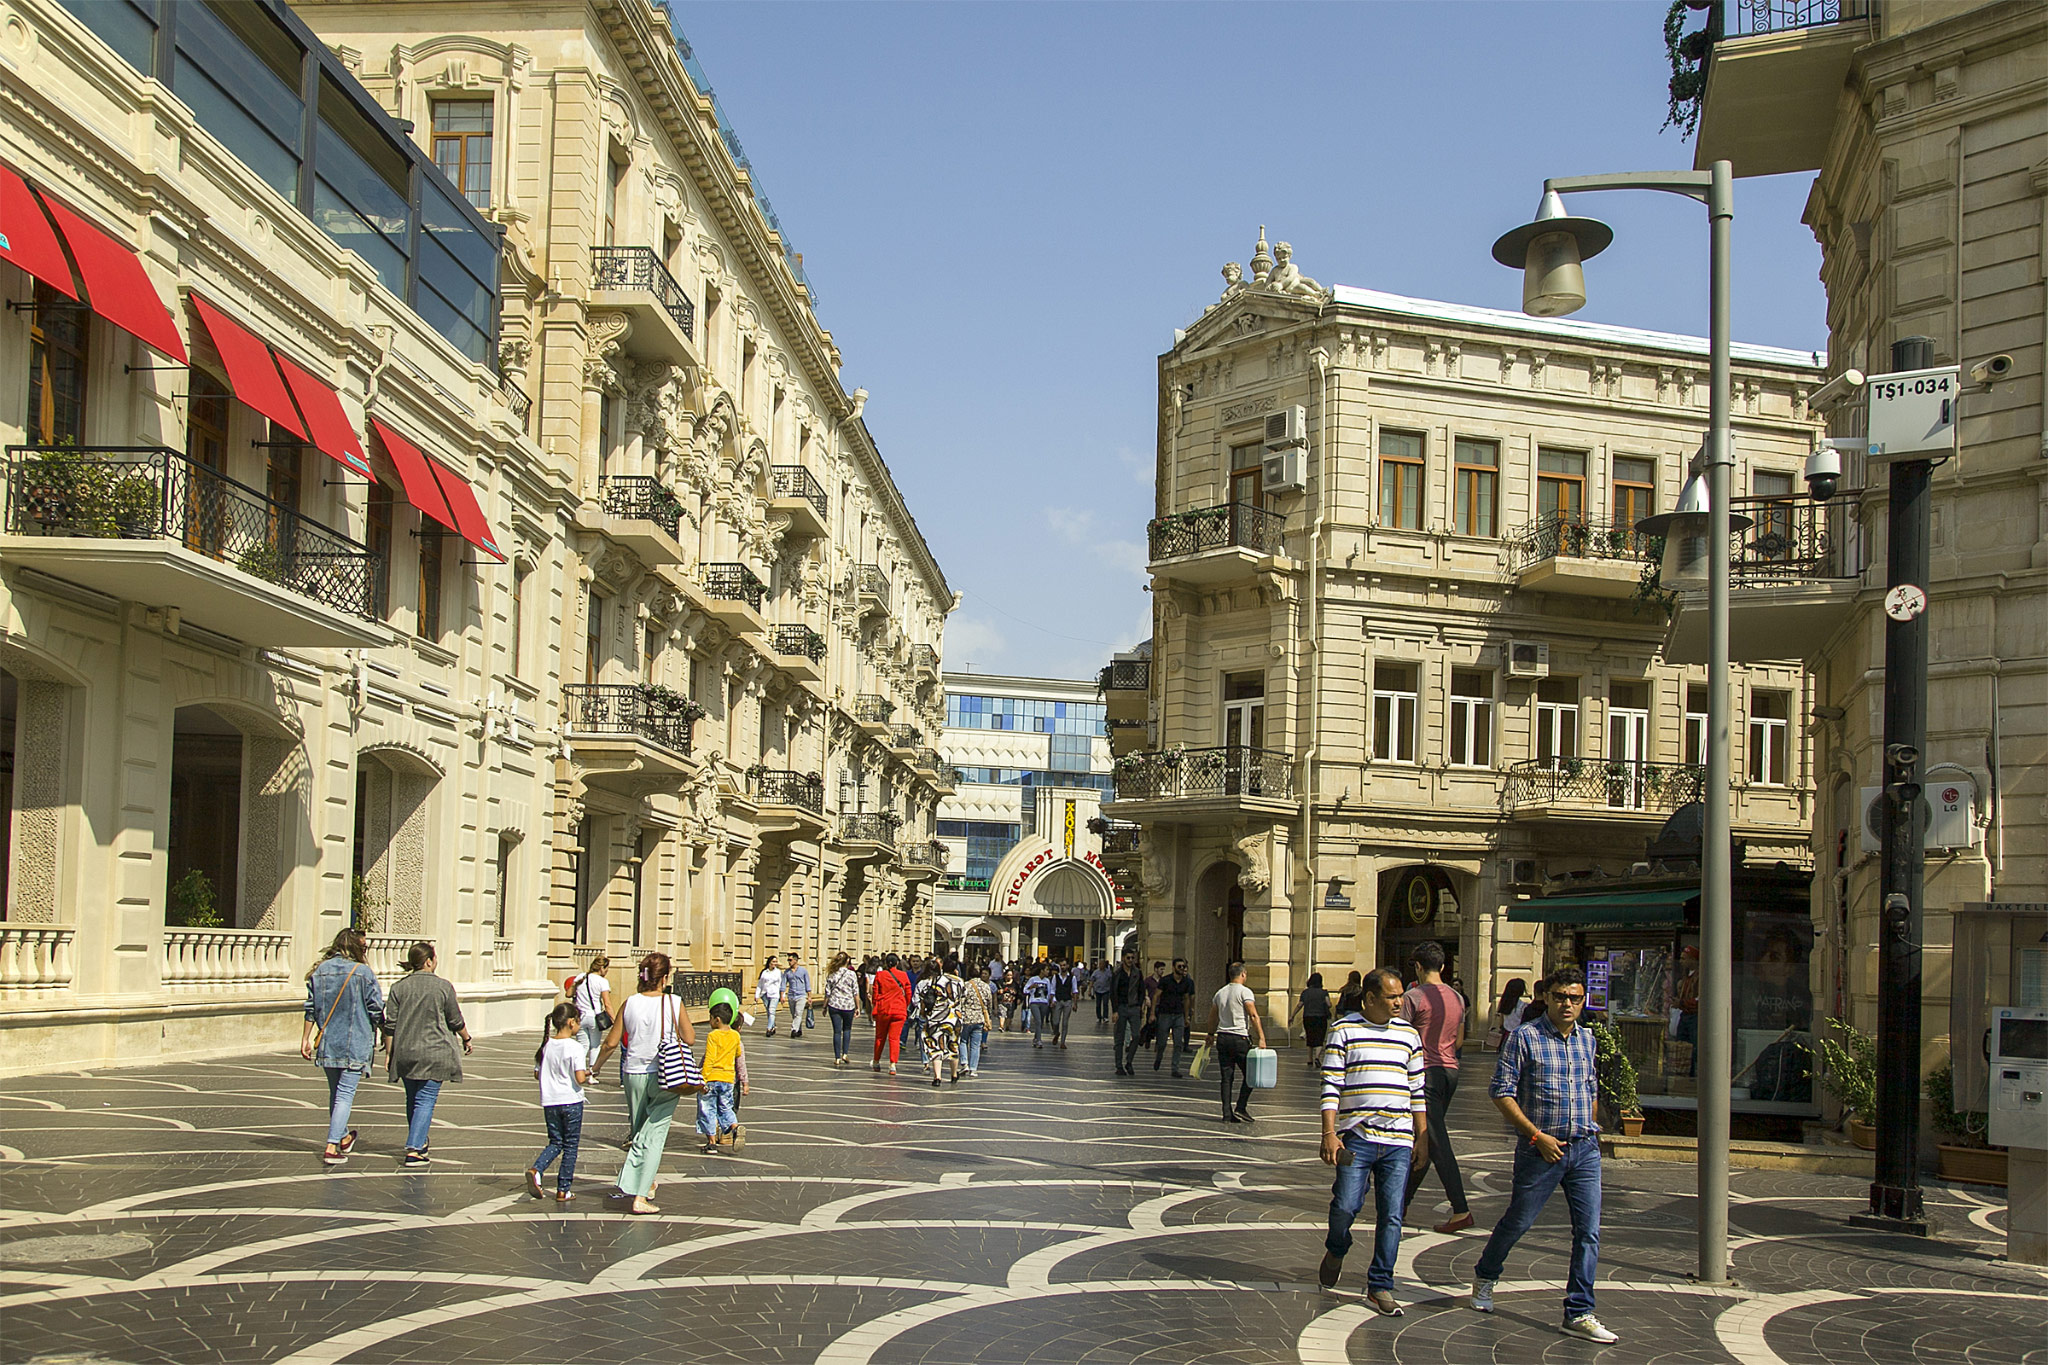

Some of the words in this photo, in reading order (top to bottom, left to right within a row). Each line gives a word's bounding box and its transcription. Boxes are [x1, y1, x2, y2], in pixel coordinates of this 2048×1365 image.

[1875, 378, 1949, 401] TŞ1-034
[1944, 804, 1958, 812] LG
[1007, 848, 1054, 907] TİCARƏT
